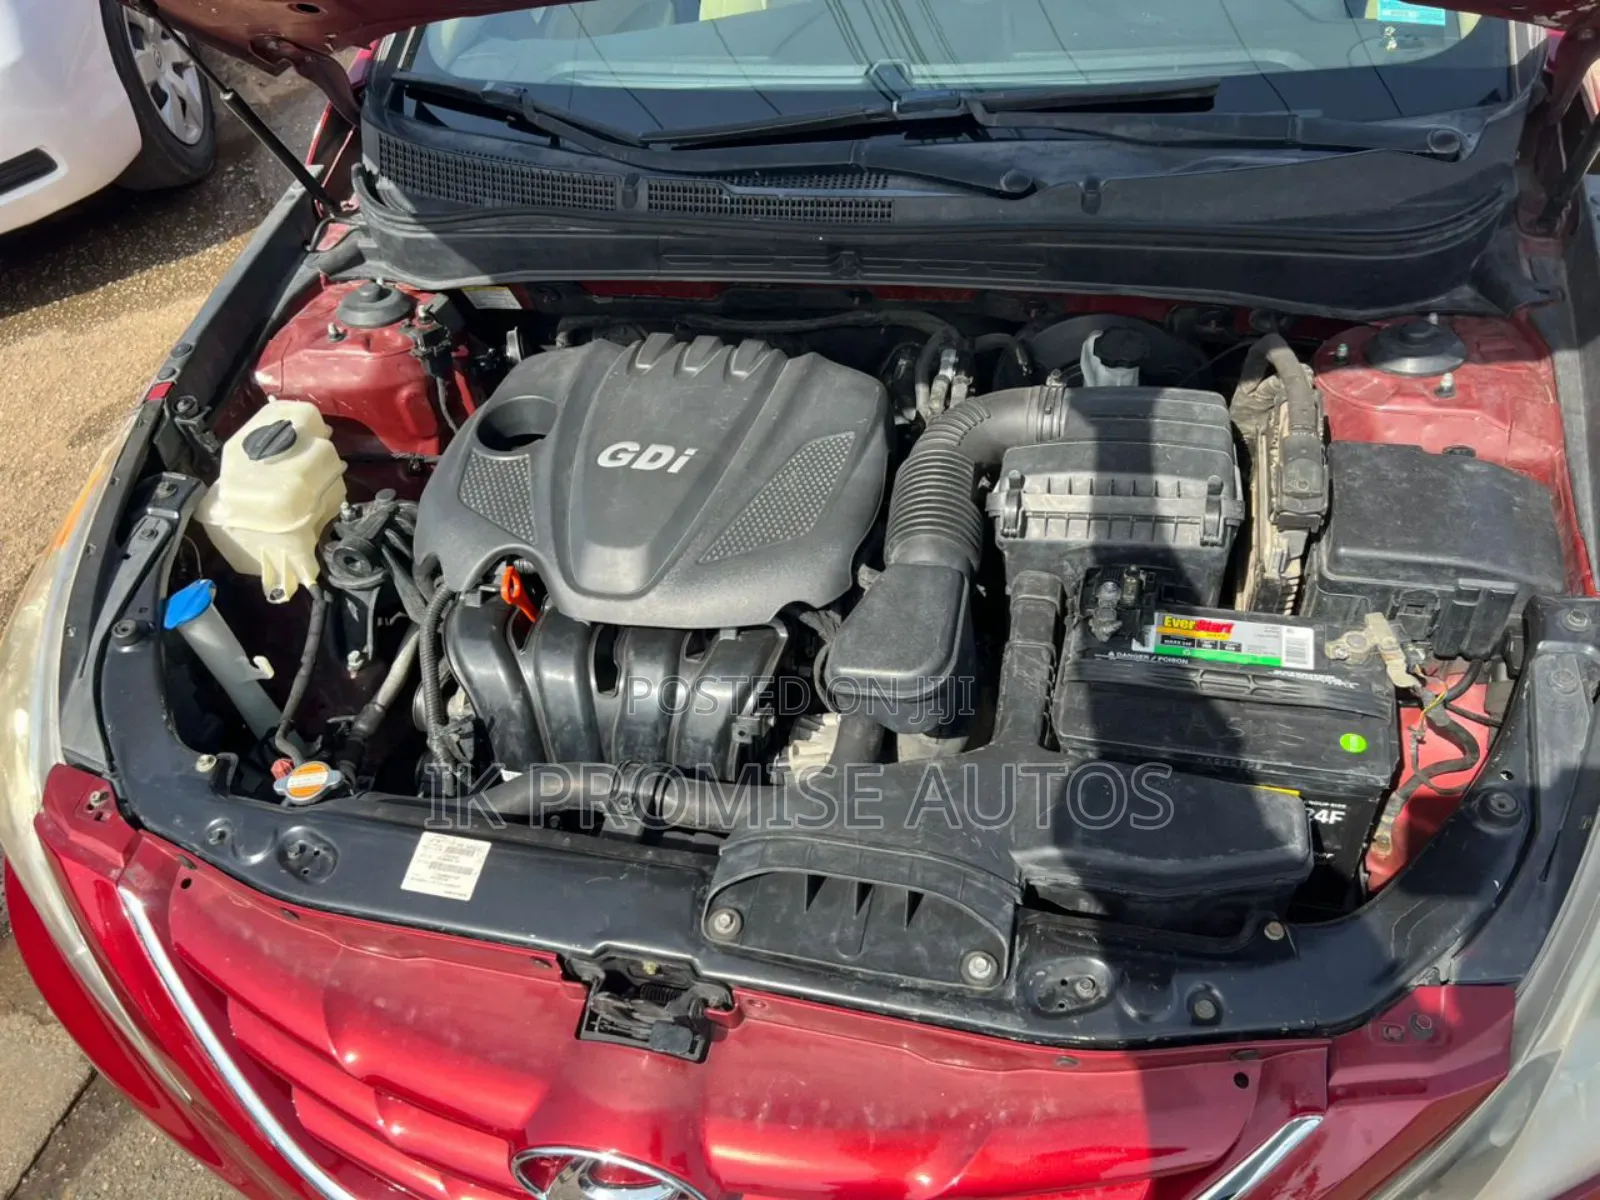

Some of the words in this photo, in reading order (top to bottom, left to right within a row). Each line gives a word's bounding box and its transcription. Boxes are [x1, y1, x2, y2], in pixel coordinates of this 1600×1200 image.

[597, 441, 699, 474] GDi
[1116, 651, 1150, 661] DANGER
[1158, 656, 1189, 665] POISON
